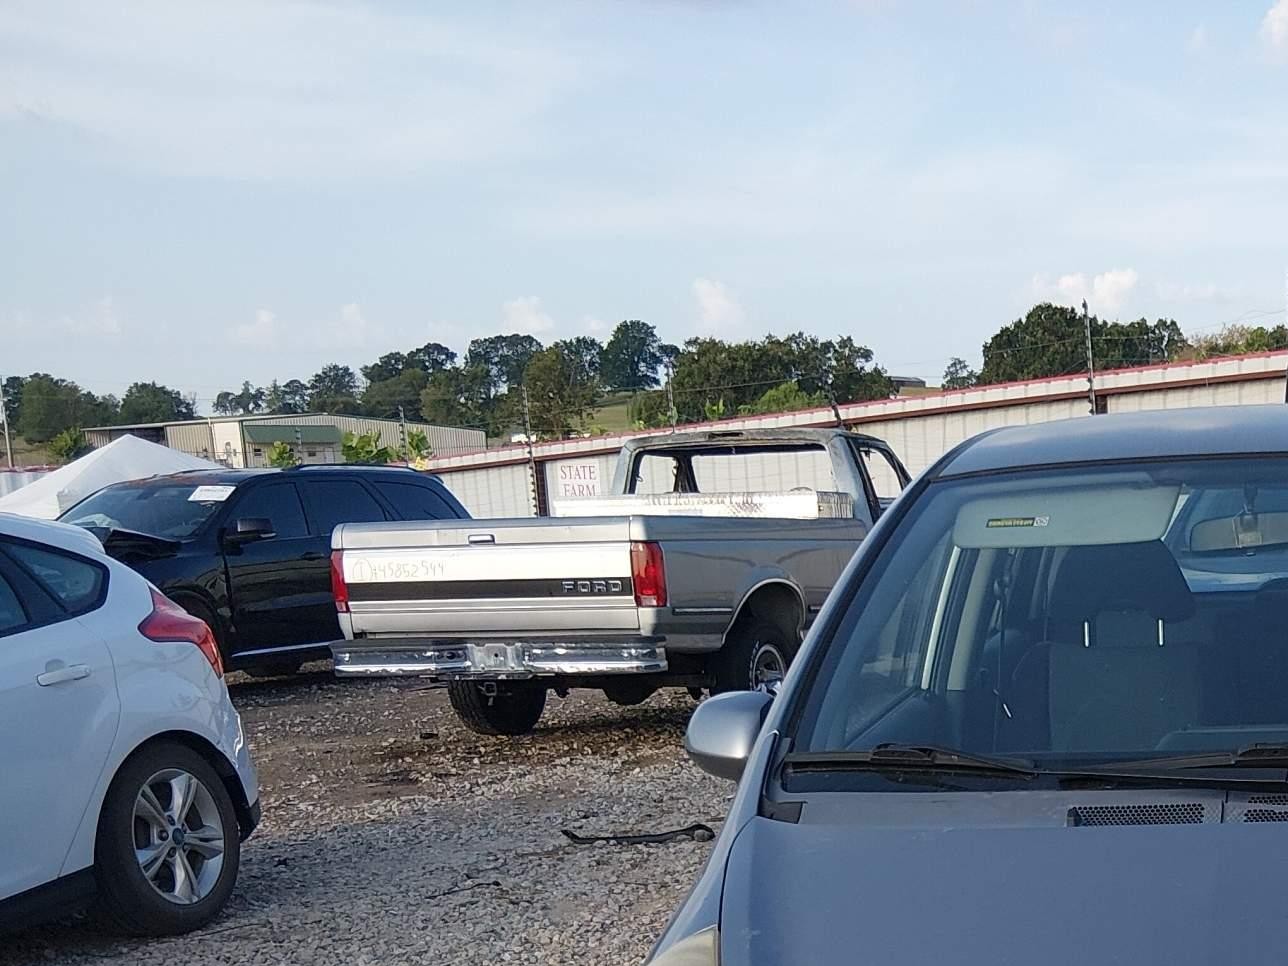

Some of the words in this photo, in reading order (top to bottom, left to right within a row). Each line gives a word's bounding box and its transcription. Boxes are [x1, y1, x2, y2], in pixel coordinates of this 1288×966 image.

[560, 465, 597, 480] STATE
[563, 483, 597, 497] FARM
[562, 580, 623, 593] FORD
